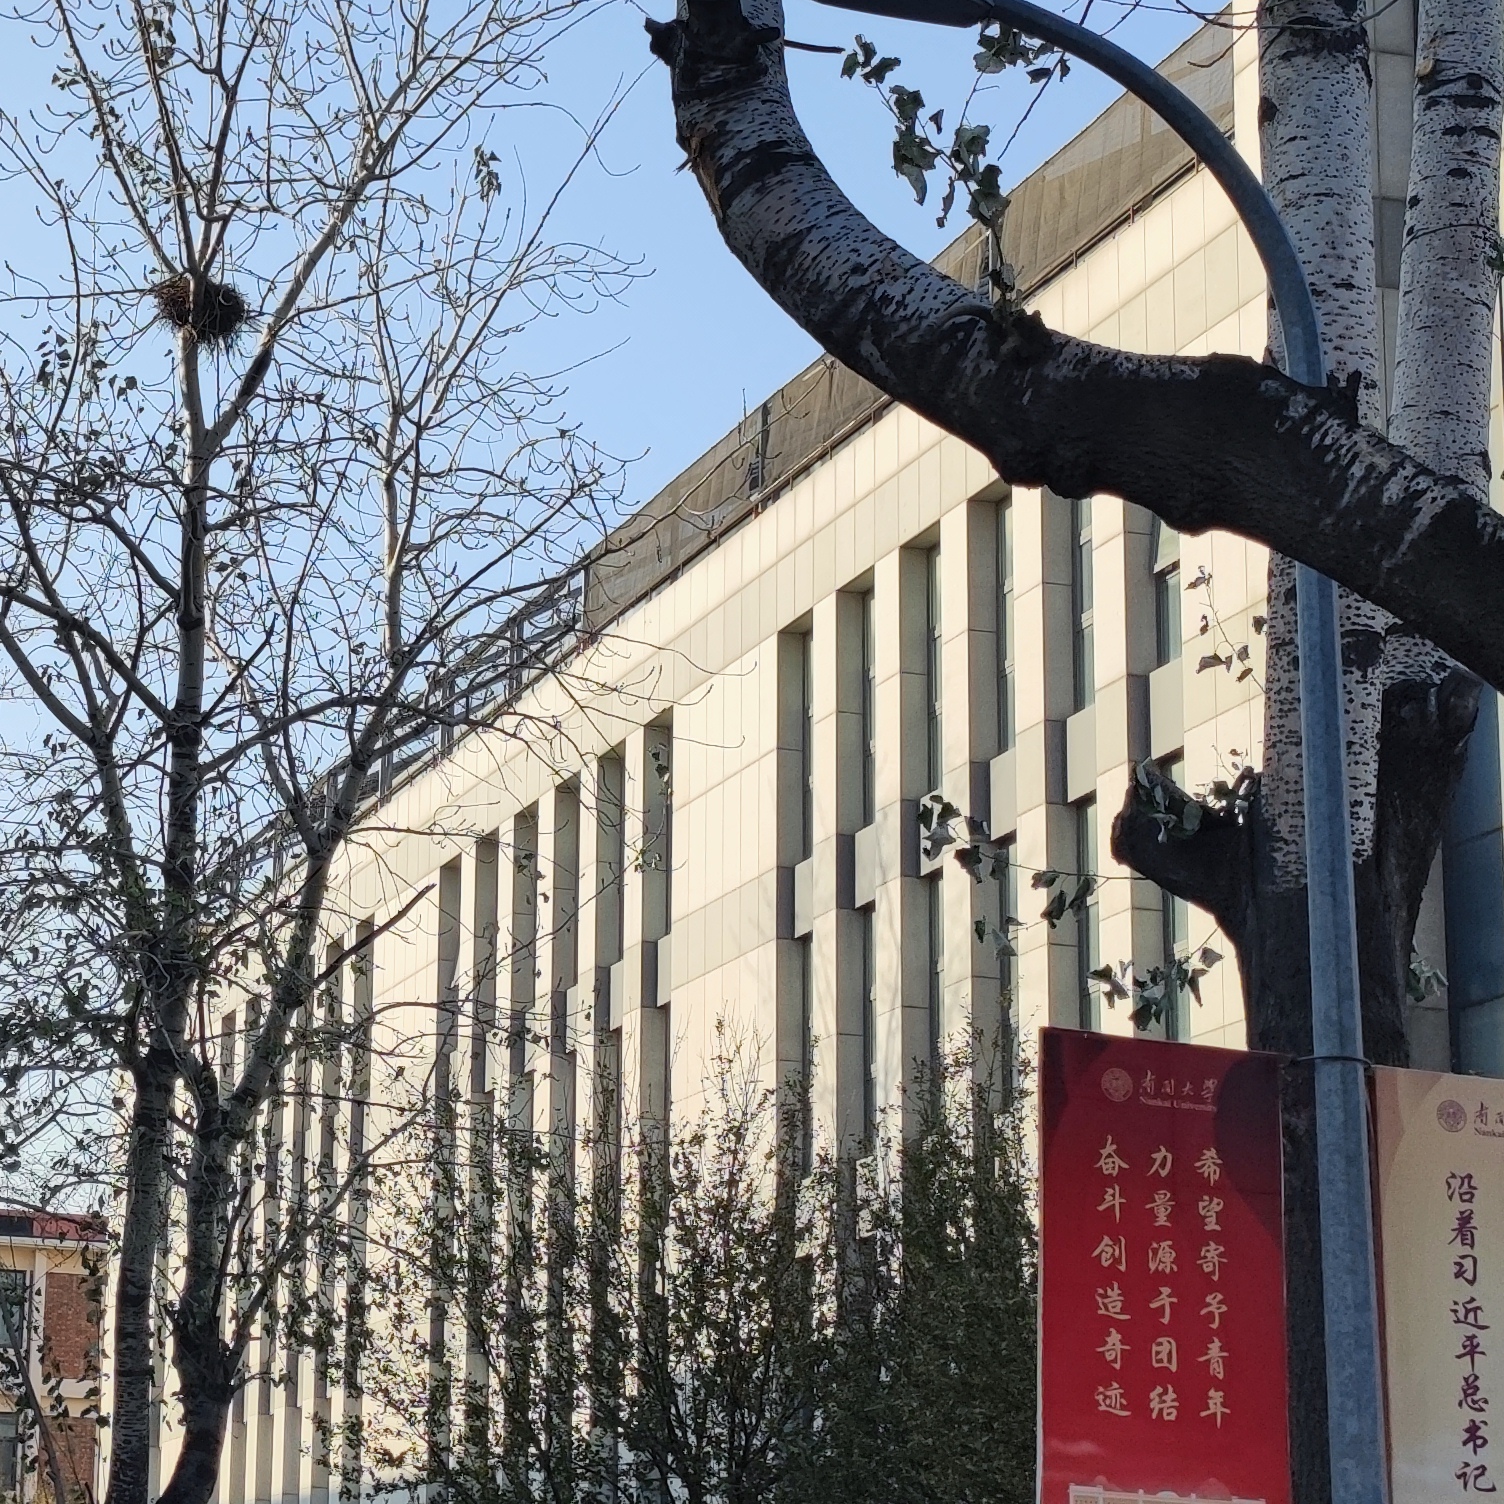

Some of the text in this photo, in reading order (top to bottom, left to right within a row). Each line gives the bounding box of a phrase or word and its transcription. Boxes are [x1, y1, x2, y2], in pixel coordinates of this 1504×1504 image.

[1092, 1135, 1131, 1417] 奋斗创造奇迹
[1145, 1146, 1179, 1421] 力量源于团结
[1194, 1148, 1231, 1429] 希望寄予青年
[1445, 1171, 1497, 1493] 沿着习近平总书记
